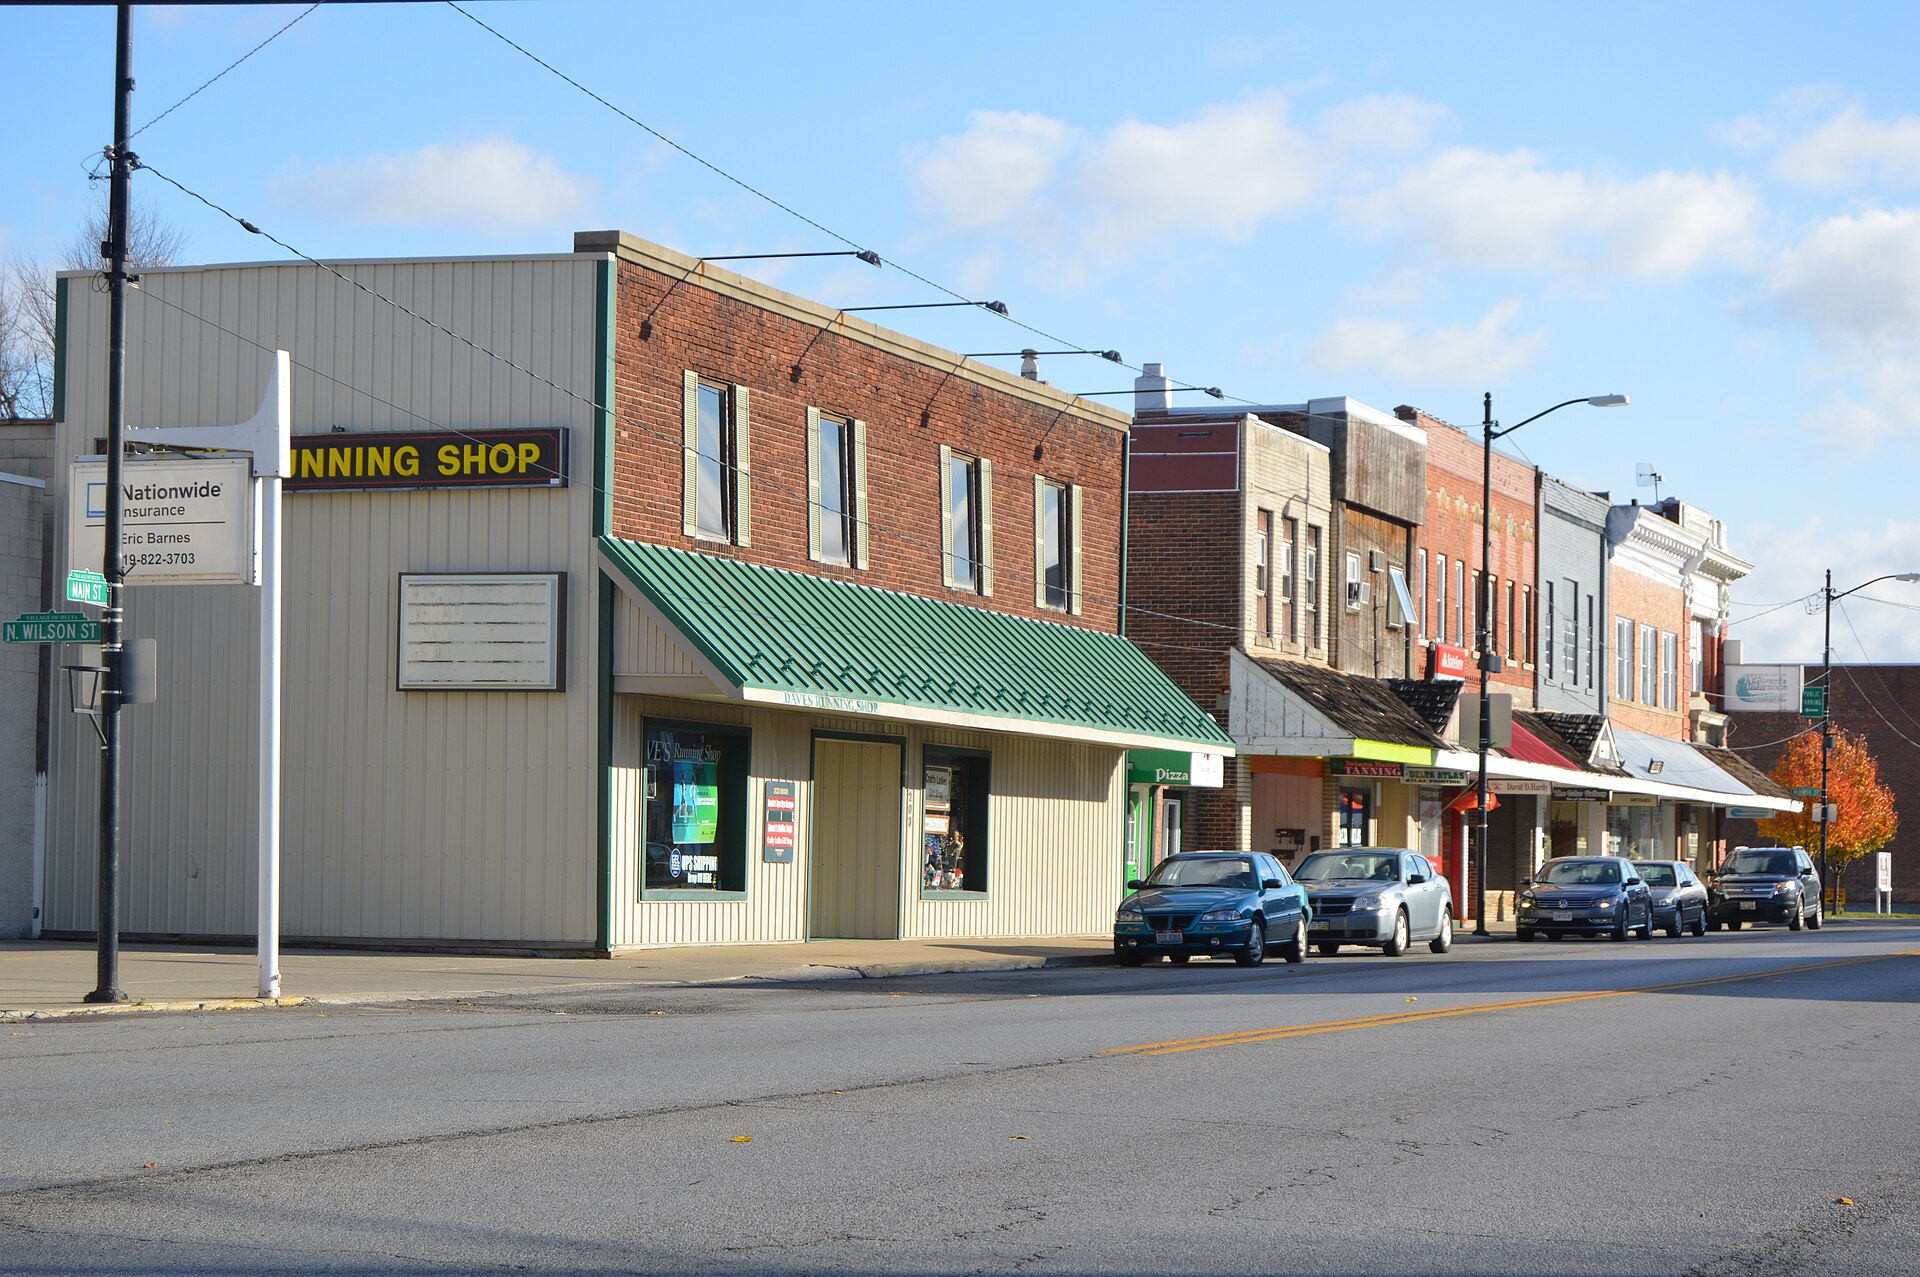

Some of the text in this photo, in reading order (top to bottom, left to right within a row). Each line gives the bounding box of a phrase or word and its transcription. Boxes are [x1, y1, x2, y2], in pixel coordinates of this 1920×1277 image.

[289, 443, 541, 479] NNING SHOP
[122, 481, 221, 501] Nationwide
[123, 505, 186, 518] nsurance
[122, 532, 191, 545] Eric Barnes
[123, 552, 195, 565] 19-822-3703
[72, 582, 102, 600] MAIN ST
[7, 623, 97, 640] N. WILSON ST
[784, 691, 878, 713] DAVES RUNNING SHOP
[647, 740, 721, 766] VE'S Running Shop
[1156, 768, 1189, 782] Pizza
[1345, 766, 1402, 776] TANNING
[1409, 770, 1464, 780] DELTA ATLAS
[1507, 783, 1523, 791] David
[681, 854, 693, 871] UPS
